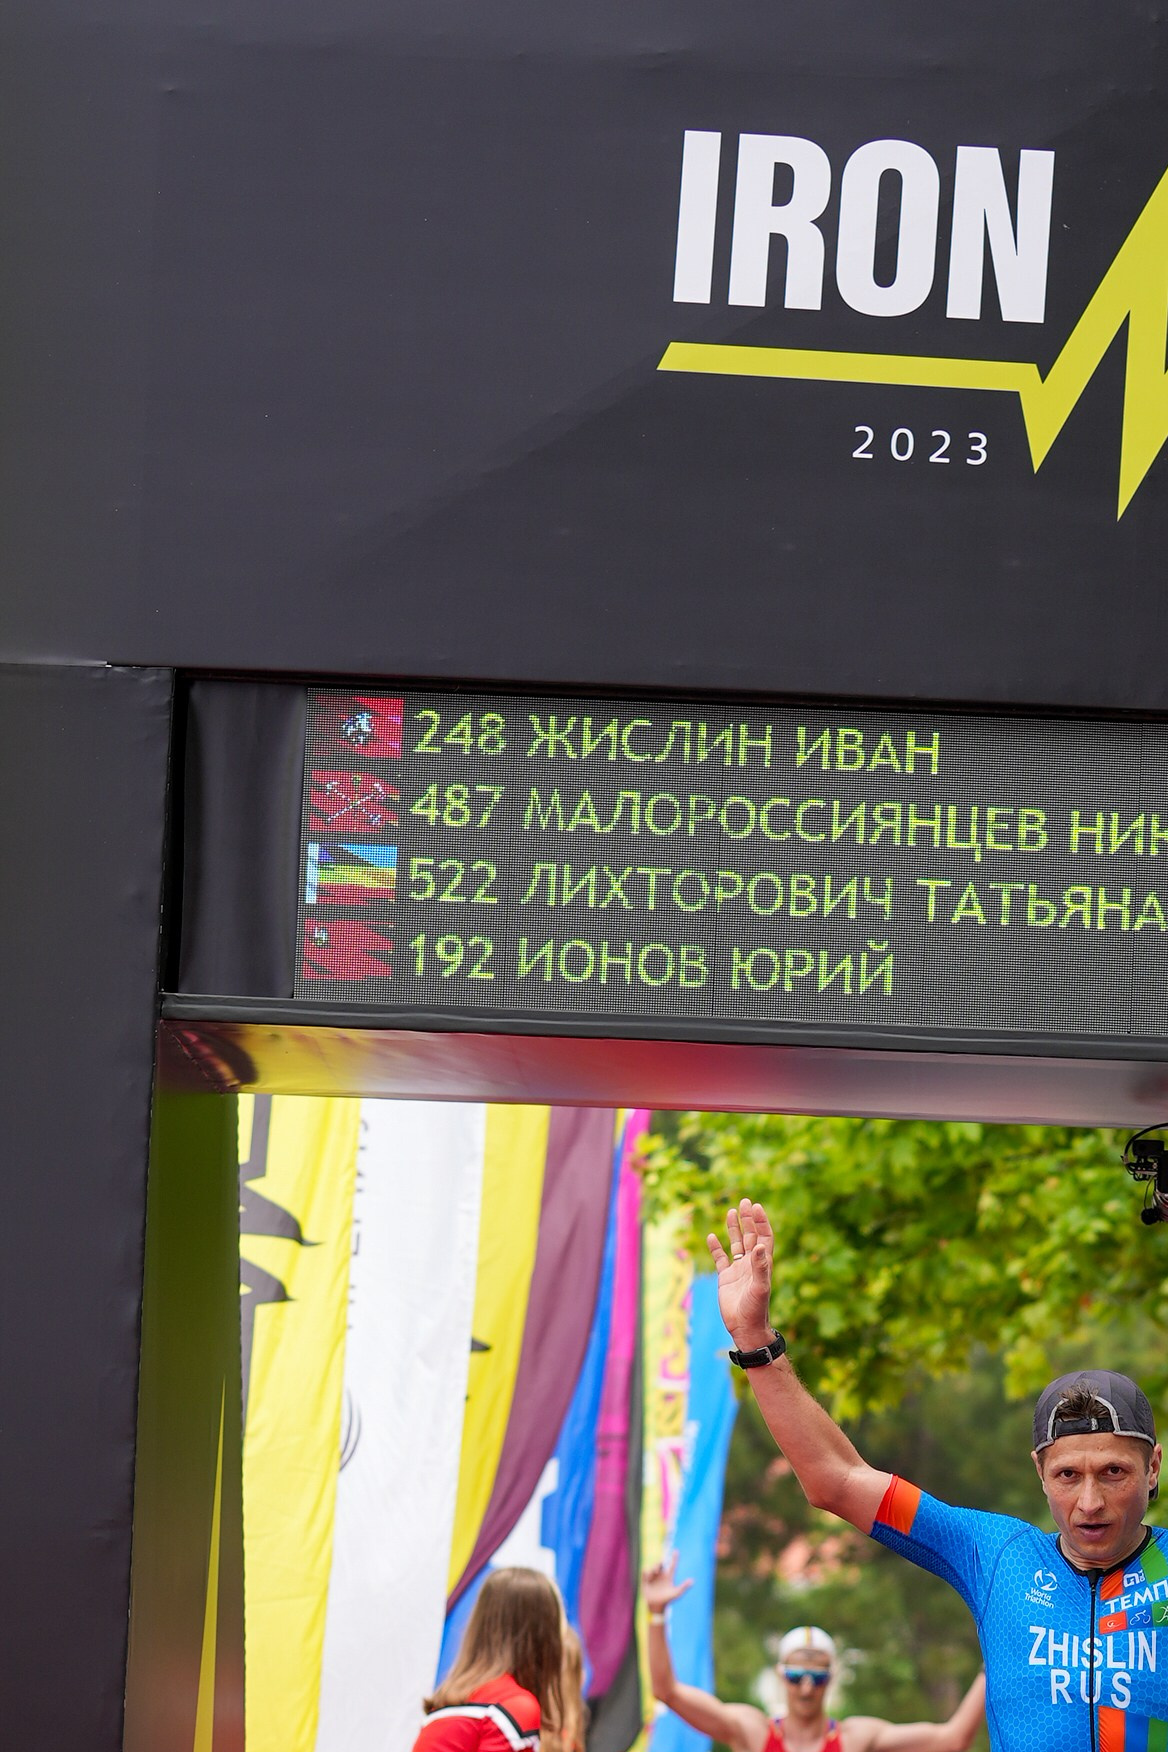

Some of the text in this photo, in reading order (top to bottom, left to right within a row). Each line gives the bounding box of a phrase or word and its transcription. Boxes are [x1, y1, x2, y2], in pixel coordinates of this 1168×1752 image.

[672, 129, 1056, 324] IRON
[852, 425, 991, 467] 2023
[413, 710, 506, 755] 248
[526, 714, 773, 769] ЖИСЛИН
[797, 726, 941, 775] ИВАН
[409, 783, 505, 828] 487
[522, 788, 1049, 861] МАЛОРОССИЯНЦЕВ
[407, 857, 499, 904] 522
[520, 863, 894, 919] ЛИХТОРОВИЧ
[916, 879, 1168, 932] ТАТЬЯНА
[407, 932, 496, 980] 192
[517, 937, 709, 989] ИОНОВ
[730, 941, 894, 996] ЮРИЙ
[1025, 1593, 1055, 1609] Triathlon
[1030, 1587, 1052, 1601] World
[1028, 1625, 1157, 1673] ZHISLIN
[1050, 1668, 1132, 1709] RUS
